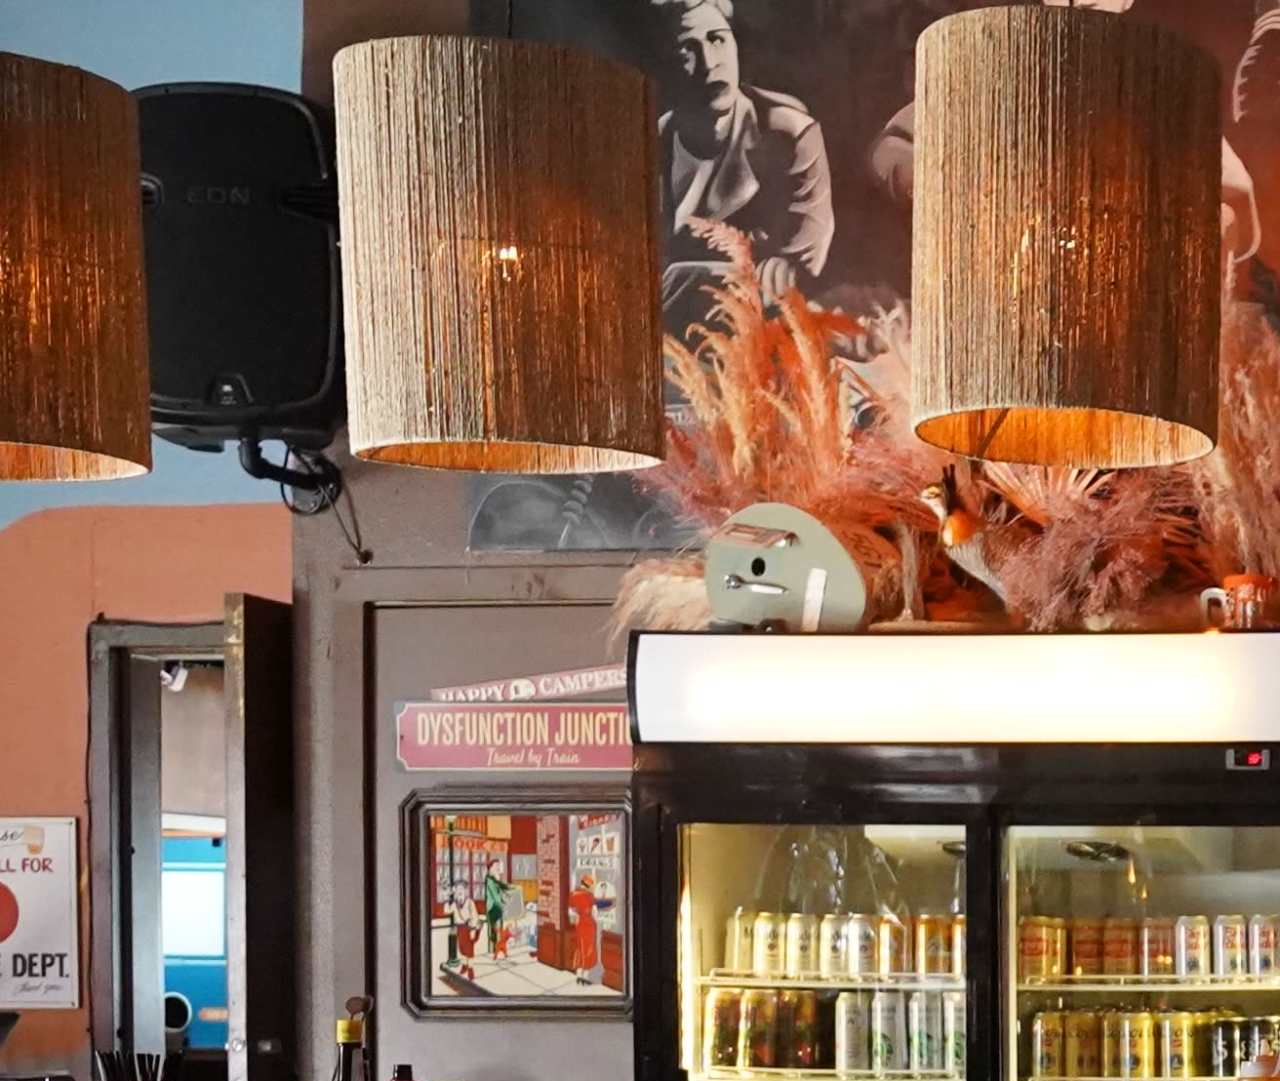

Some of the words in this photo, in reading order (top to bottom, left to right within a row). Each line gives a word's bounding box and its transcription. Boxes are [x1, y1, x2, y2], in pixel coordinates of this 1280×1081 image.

[417, 712, 549, 746] DYSFUNCTION
[487, 748, 525, 767] Travel
[527, 749, 544, 768] by
[546, 747, 580, 765] Train
[21, 857, 54, 873] FOR
[12, 953, 70, 978] DEPT.
